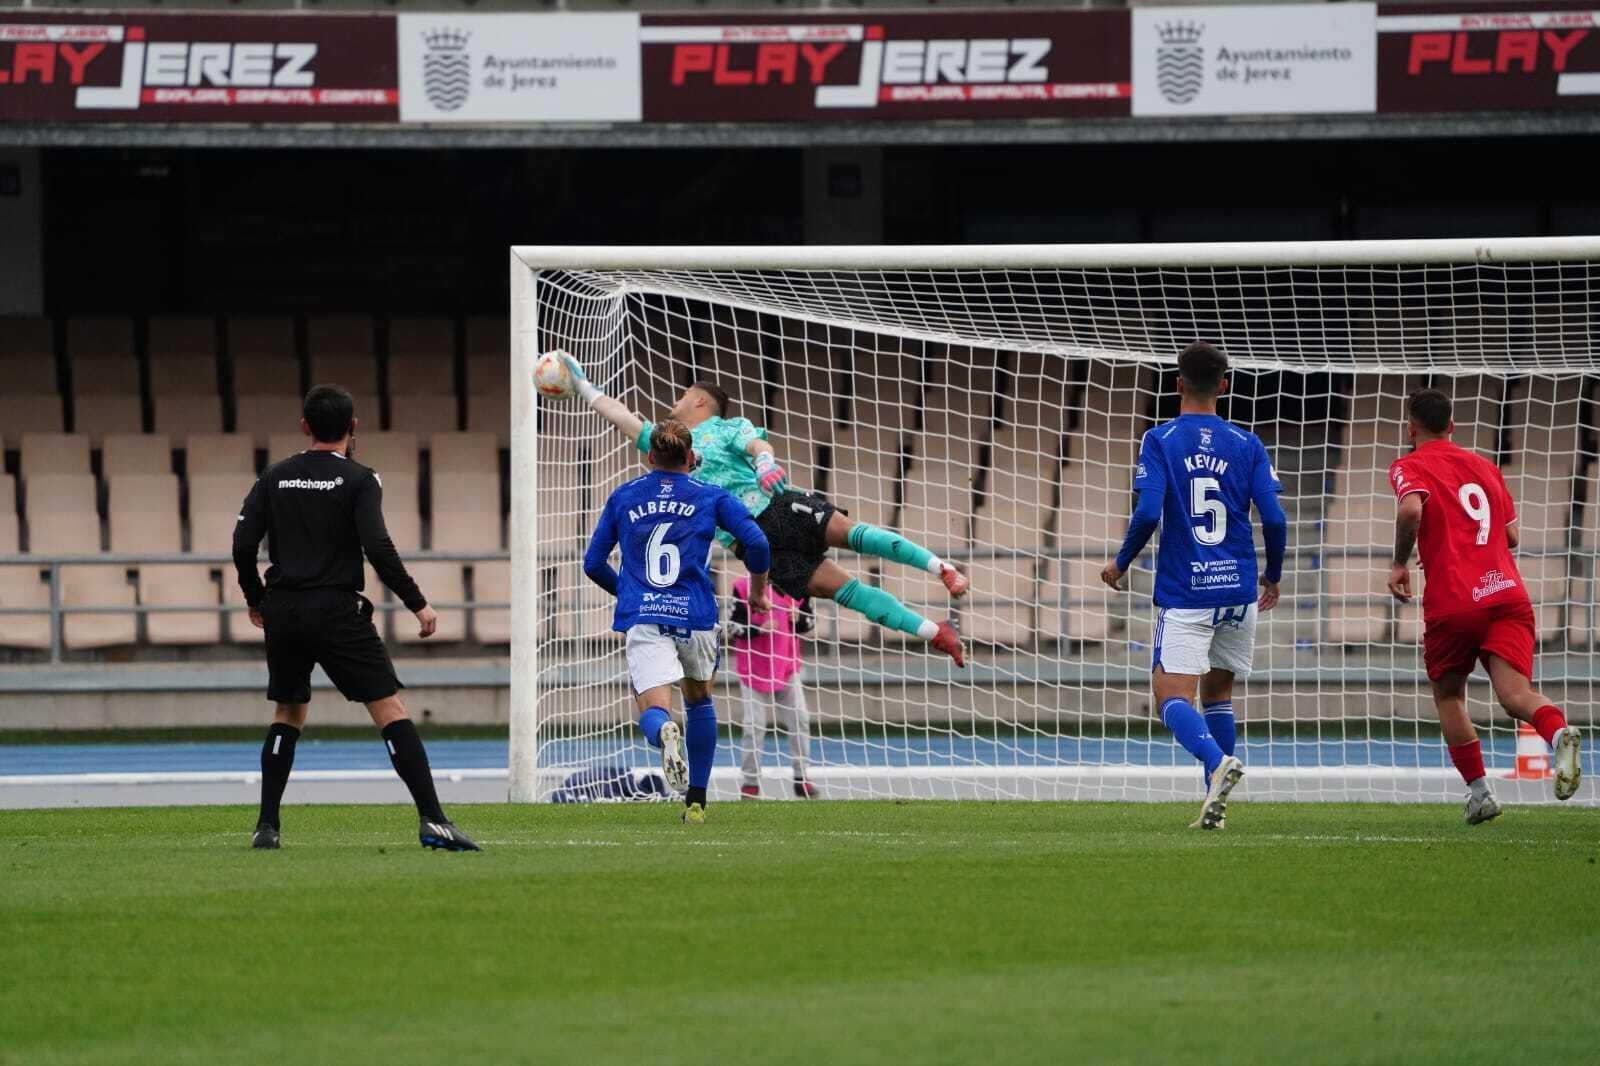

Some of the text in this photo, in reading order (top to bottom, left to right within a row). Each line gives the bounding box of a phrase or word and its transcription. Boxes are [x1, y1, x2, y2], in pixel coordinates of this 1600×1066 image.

[0, 42, 105, 84] AY
[483, 54, 616, 71] Ayuntamiento
[1217, 45, 1352, 63] Ayuntamiento
[1408, 30, 1590, 75] PLAY
[671, 43, 846, 86] PLAY
[1217, 66, 1292, 83] de Jerez
[483, 74, 557, 92] de Jerez
[1184, 454, 1229, 475] KEVIN
[279, 478, 335, 491] matchapp
[628, 501, 696, 523] ALBERTO
[1190, 477, 1227, 546] 5
[1458, 483, 1491, 545] 9
[646, 522, 681, 588] 6
